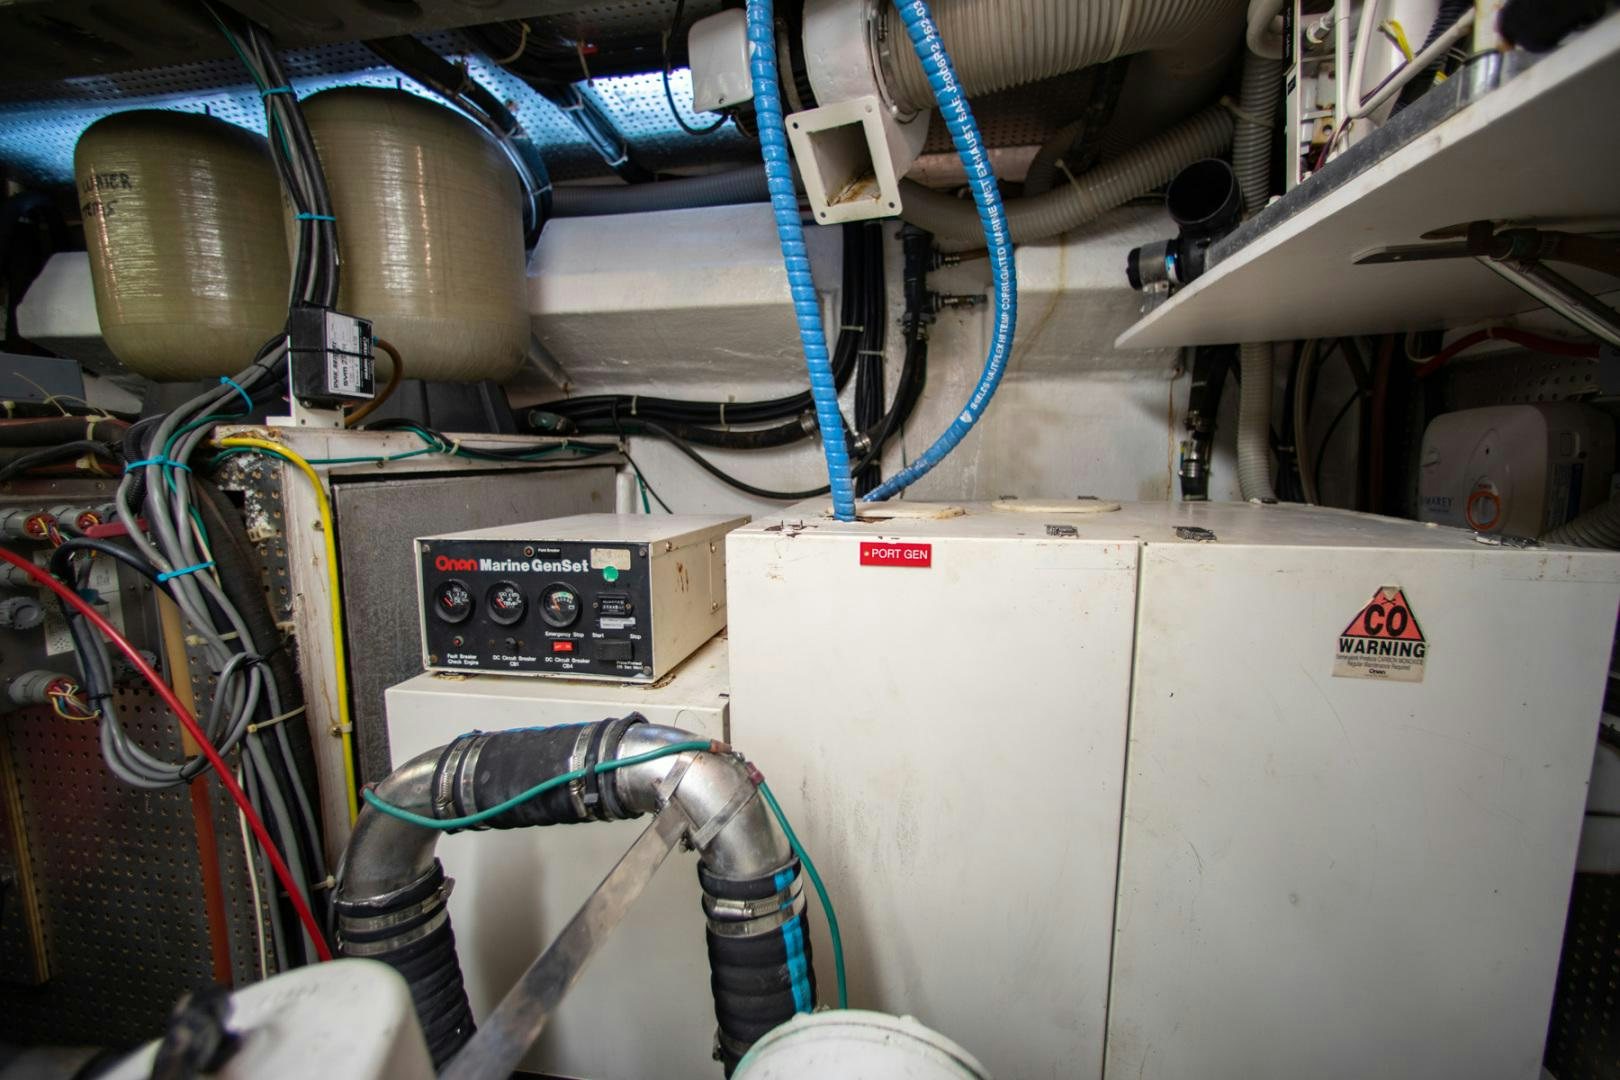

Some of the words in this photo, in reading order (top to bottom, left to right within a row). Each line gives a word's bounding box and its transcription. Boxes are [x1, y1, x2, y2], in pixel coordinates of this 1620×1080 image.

[961, 124, 988, 178] EXHAUST
[978, 179, 995, 205] WET
[988, 205, 1005, 246] MARINE
[435, 555, 478, 571] Onan
[479, 558, 530, 572] Marine
[531, 559, 590, 573] GenSet
[871, 548, 902, 559] PORT
[903, 549, 928, 560] GEN
[1364, 604, 1408, 637] CO
[1339, 638, 1426, 658] WARNING
